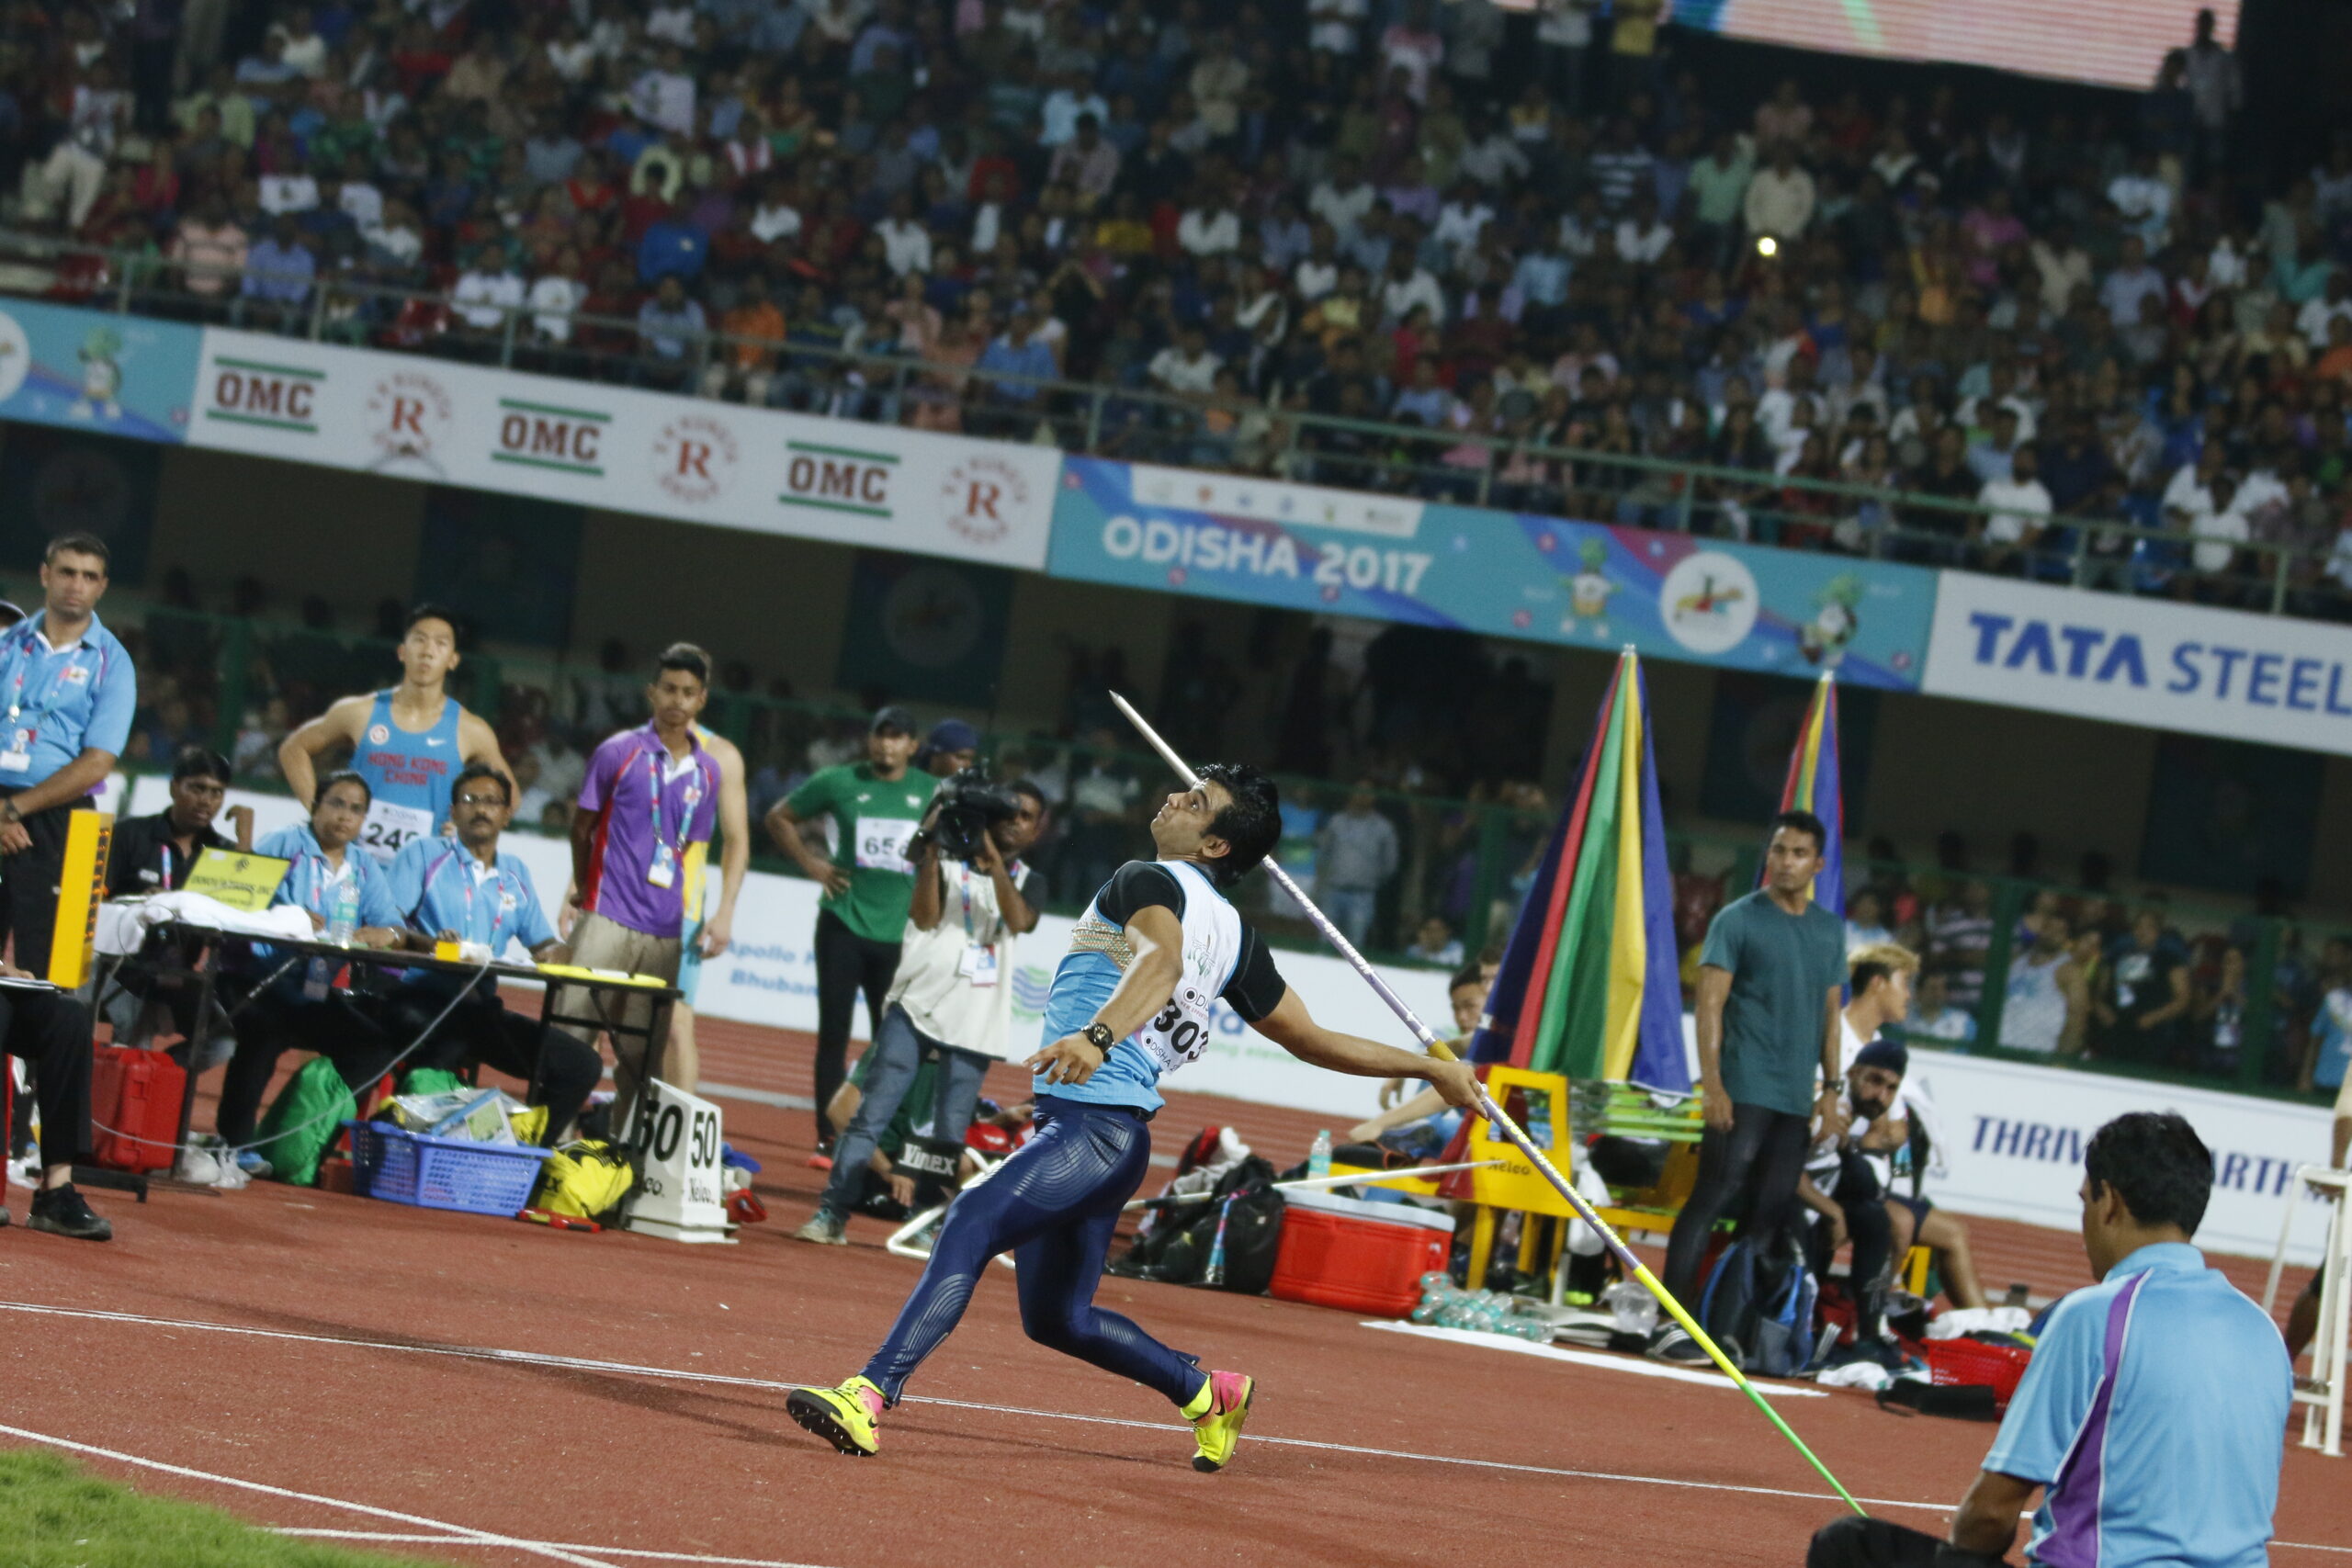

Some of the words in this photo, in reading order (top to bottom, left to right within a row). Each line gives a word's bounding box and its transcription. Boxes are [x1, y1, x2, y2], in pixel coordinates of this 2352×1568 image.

[216, 372, 314, 419] OMC
[501, 414, 600, 461] OMC
[788, 457, 888, 503] OMC
[1102, 515, 1300, 579] ODISHA
[1314, 542, 1433, 594] 2017
[1969, 611, 2148, 688] TATA
[2165, 640, 2352, 716] STEEL
[368, 751, 405, 768] HONG
[411, 757, 447, 775] KONG
[385, 769, 427, 785] CHINA
[731, 970, 819, 997] Bhuban
[1154, 998, 1208, 1060] 303
[691, 1111, 718, 1168] 50
[899, 1142, 956, 1176] Vinex
[1973, 1114, 2088, 1166] THRIV
